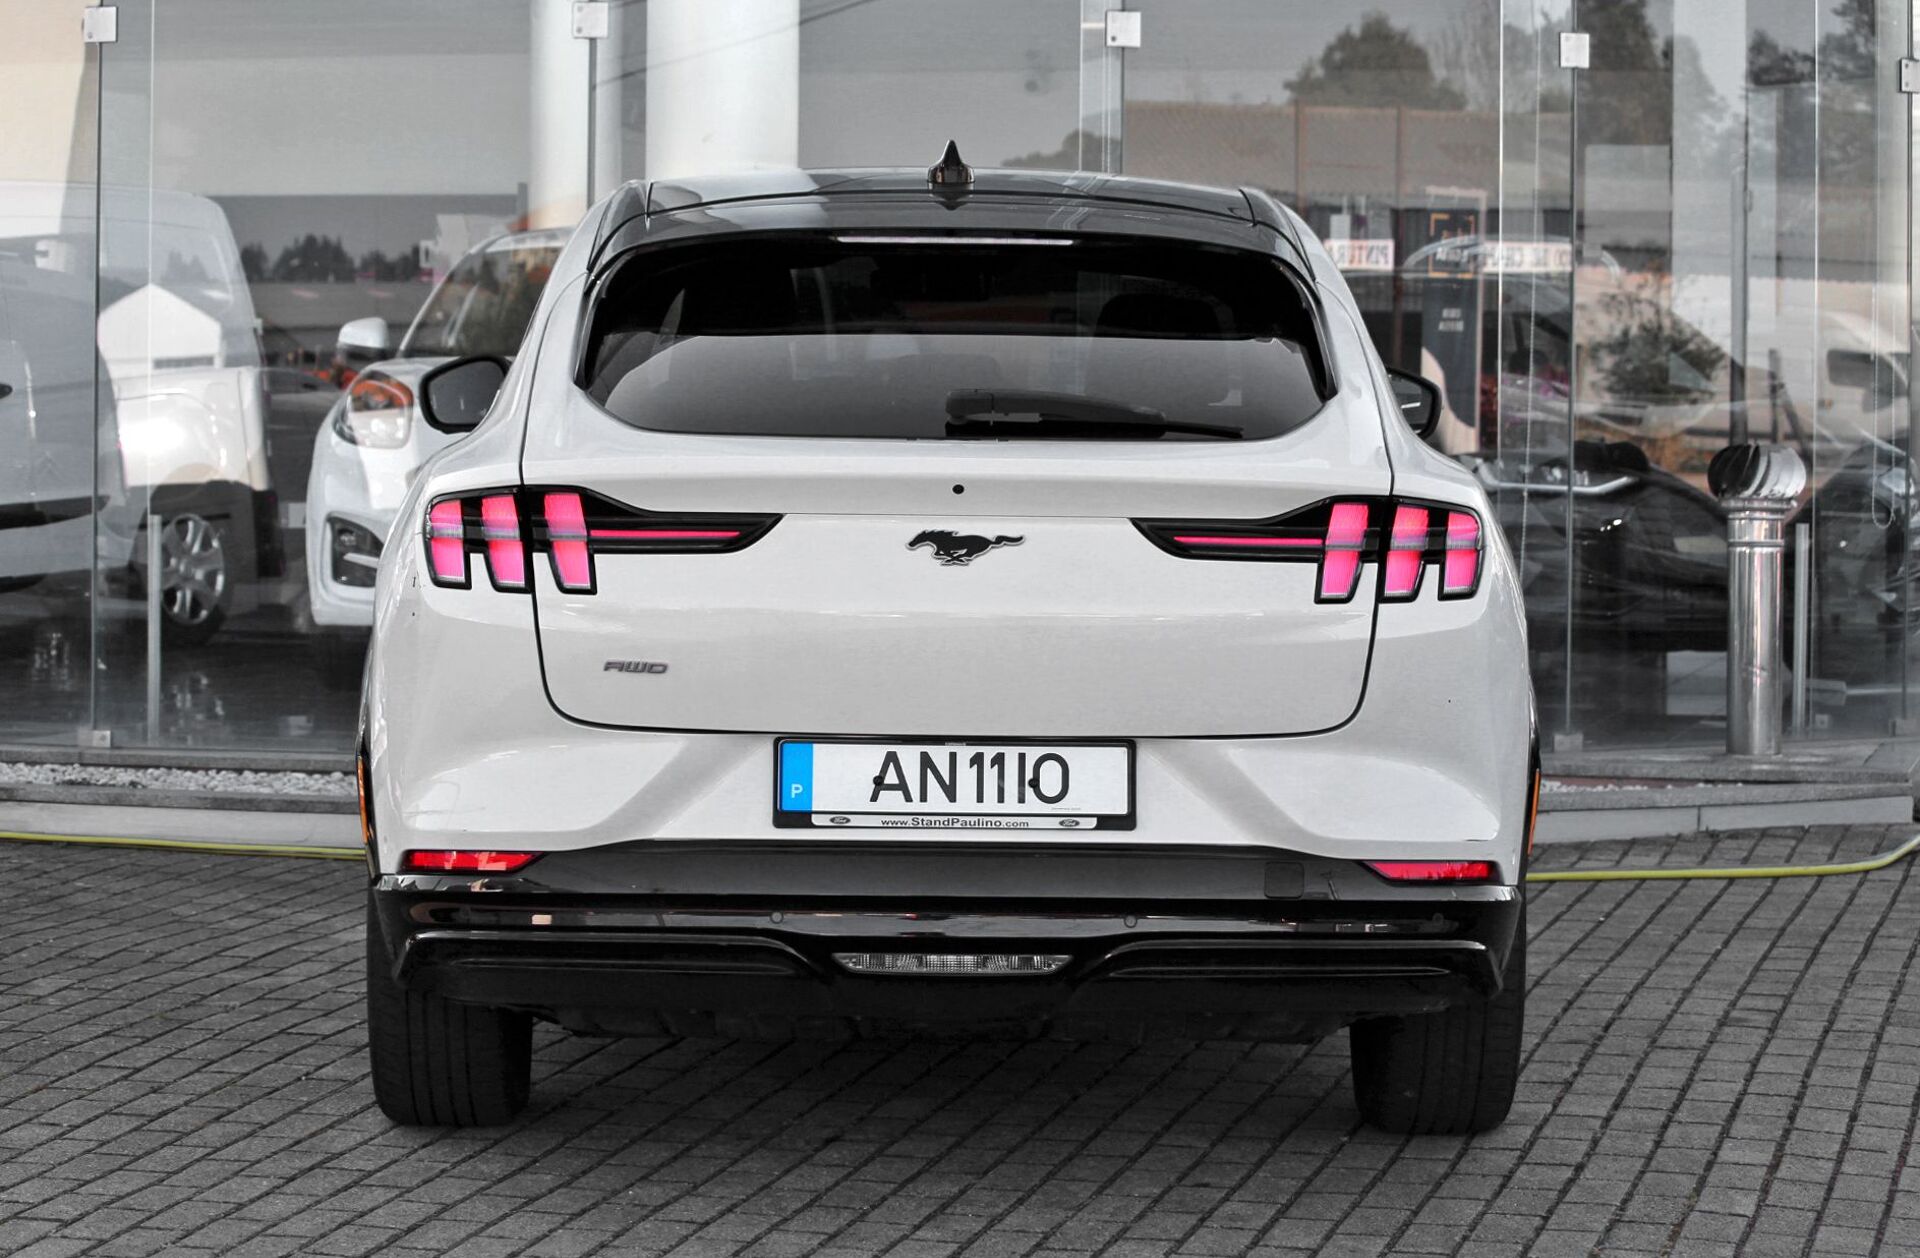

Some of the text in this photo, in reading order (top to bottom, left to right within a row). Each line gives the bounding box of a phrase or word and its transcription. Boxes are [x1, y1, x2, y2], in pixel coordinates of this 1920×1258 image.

[603, 660, 669, 674] AWD
[791, 783, 804, 799] P
[880, 816, 1029, 829] www.StandPaulino.com
